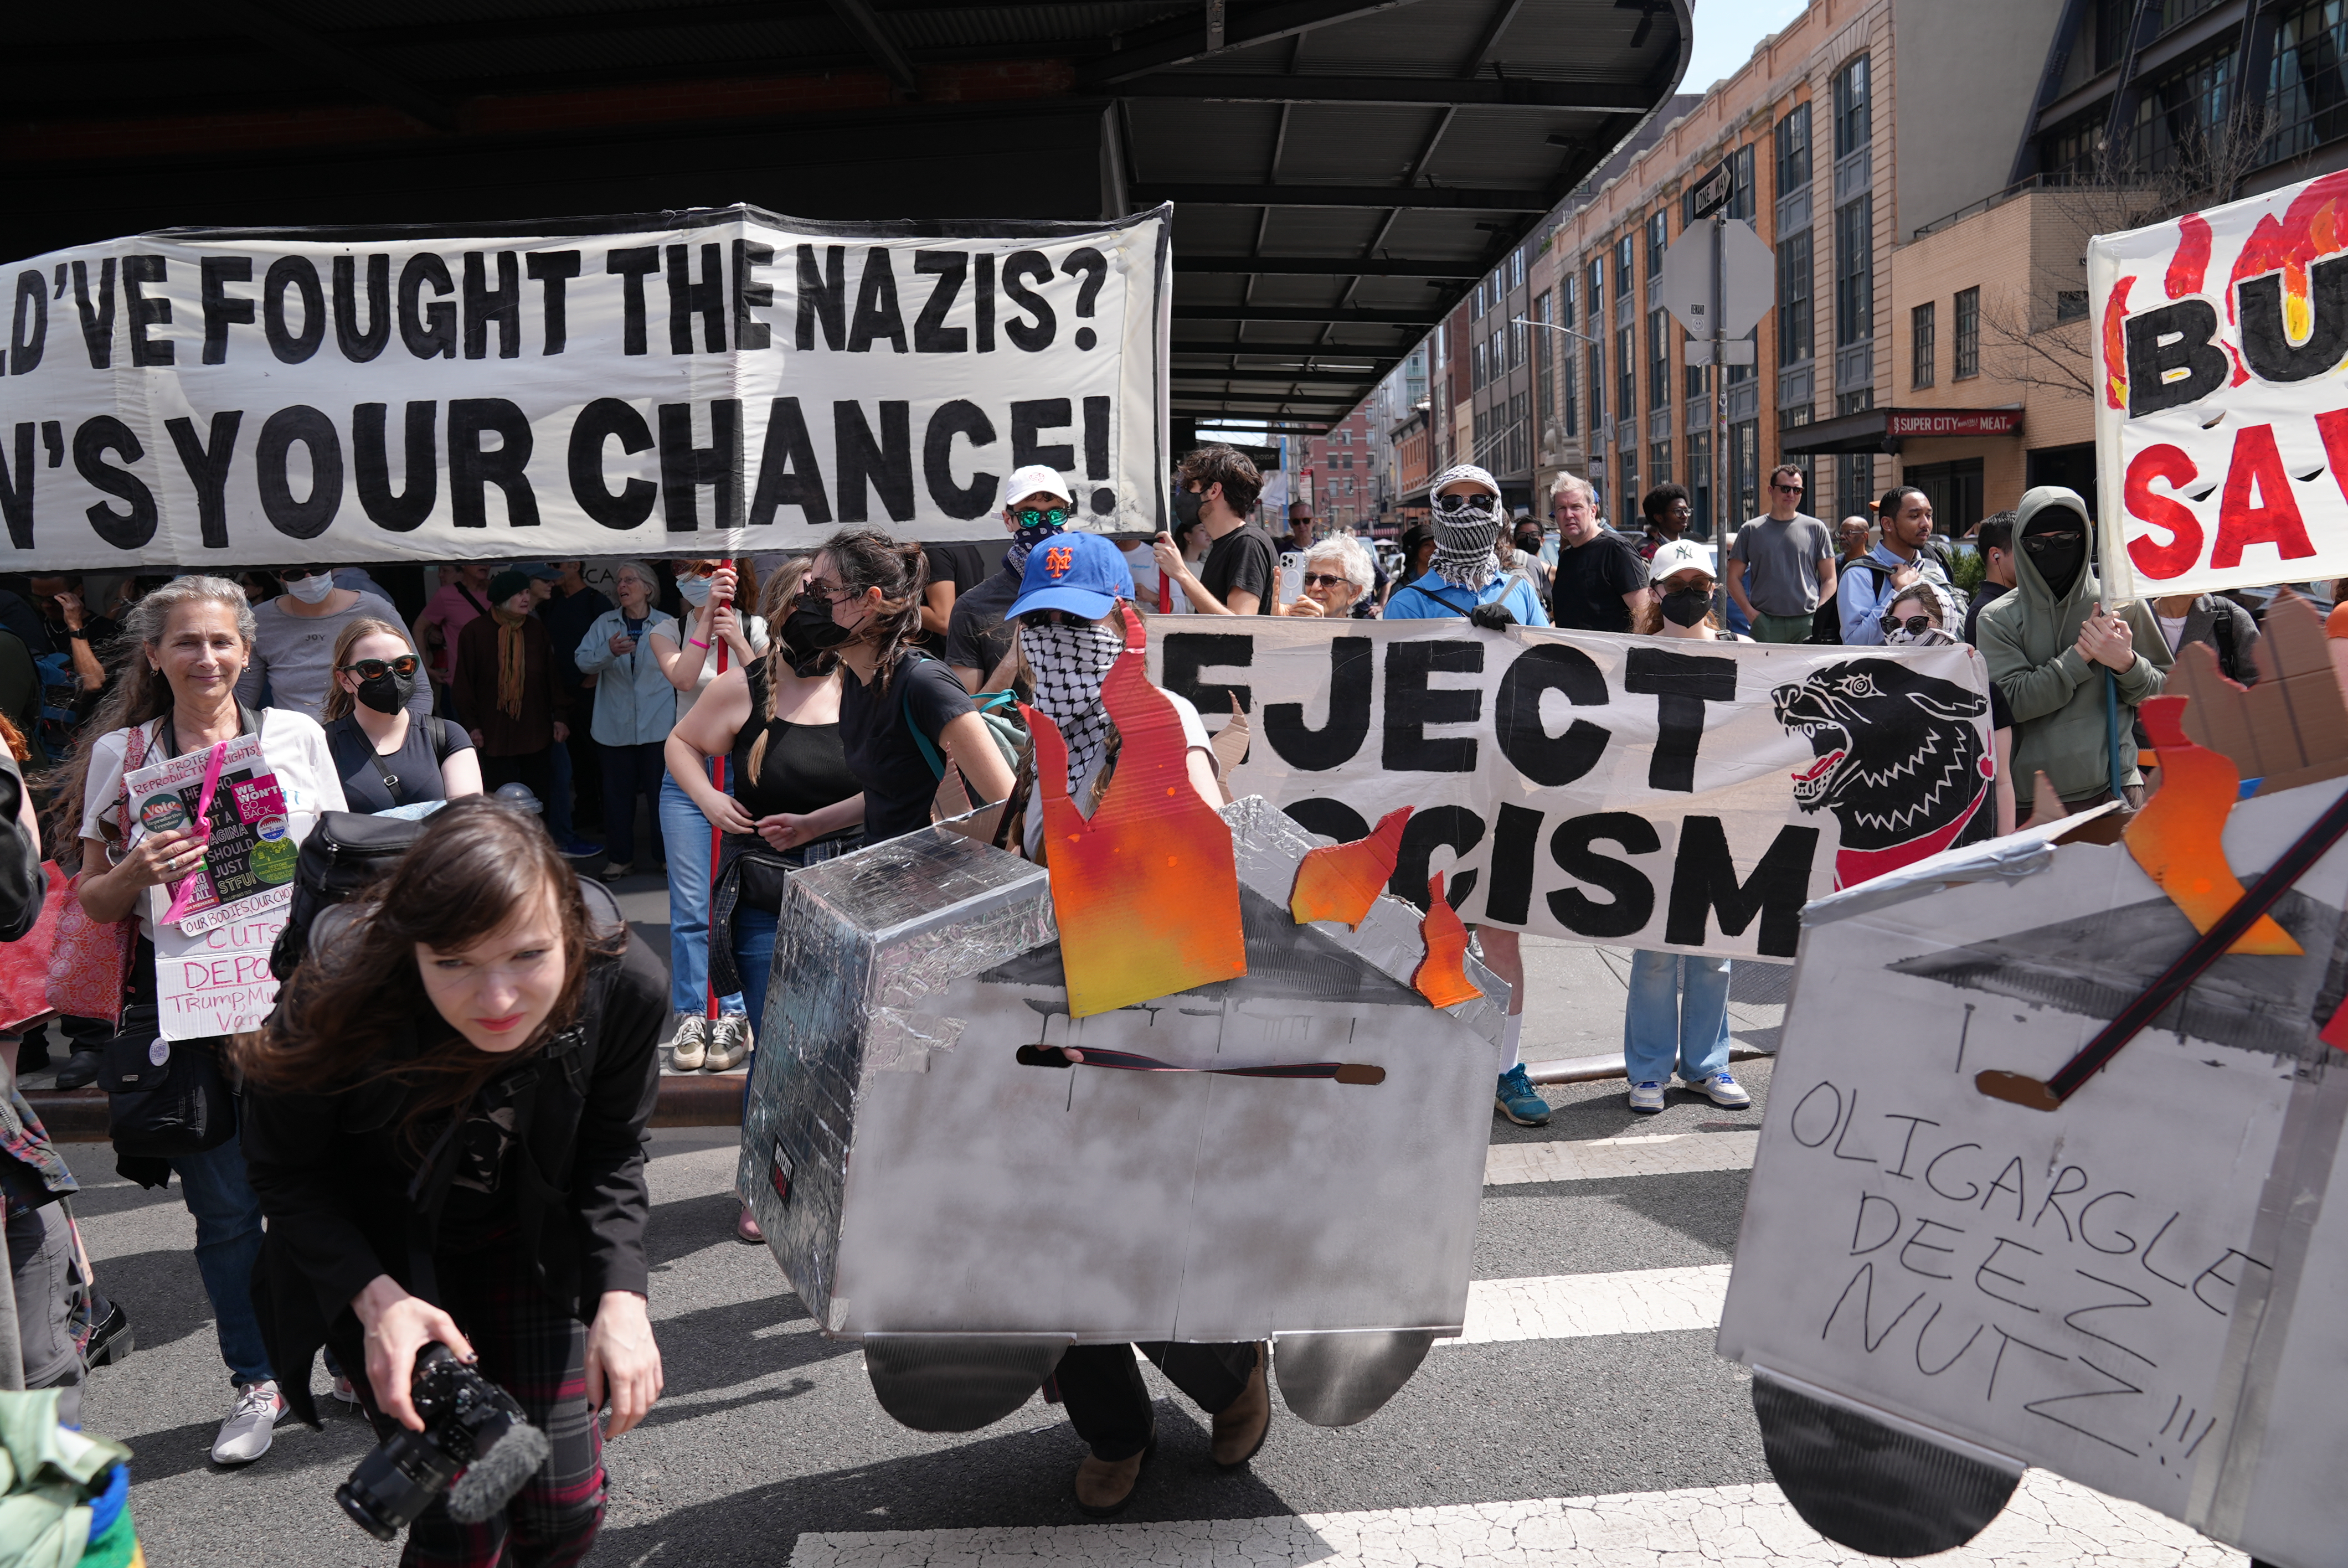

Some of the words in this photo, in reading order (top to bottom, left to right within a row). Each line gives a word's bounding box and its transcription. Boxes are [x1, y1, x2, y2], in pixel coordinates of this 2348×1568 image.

[1698, 185, 1710, 209] ONE
[1714, 172, 1727, 197] WAY
[0, 255, 175, 376] D'VE
[201, 250, 581, 364] FOUGHT
[606, 239, 774, 355] THE
[795, 244, 1108, 353] NAZIS?
[2125, 252, 2348, 420] BU
[1901, 417, 1932, 431] SUPER
[1934, 416, 1959, 431] CITY
[1980, 416, 2007, 430] MEAT
[165, 398, 541, 549] YOUR
[568, 396, 1116, 532] CHANCE!
[1676, 544, 1693, 559] NY
[133, 762, 209, 797] REPRODUCTIV
[222, 741, 262, 766] RIGHTS!
[167, 750, 213, 773] PROTEC
[184, 786, 199, 801] HE
[216, 776, 233, 792] HO
[234, 783, 255, 796] WE
[237, 786, 278, 803] WON'T
[143, 801, 176, 816] Vote
[241, 800, 259, 812] GO
[244, 805, 275, 821] BACK.
[147, 812, 182, 826] Reproductive
[155, 819, 178, 829] Freedom
[210, 814, 220, 828] OT
[225, 811, 234, 824] A
[206, 822, 249, 847] AGINA
[207, 838, 255, 863] SHOULD
[214, 858, 244, 878] JUST
[218, 871, 257, 895] STFU!
[196, 889, 212, 901] ALL
[186, 917, 209, 932] OUR
[250, 895, 275, 910] OUR
[184, 956, 275, 988] DEPO
[249, 986, 275, 1005] Mu
[216, 1011, 270, 1032] Van
[775, 1142, 793, 1182] BOYCOTT
[1791, 1081, 2272, 1315] OLIGARGLE
[1850, 1191, 2157, 1367] DEEZ
[1822, 1262, 2216, 1479] NUTZ!!!
